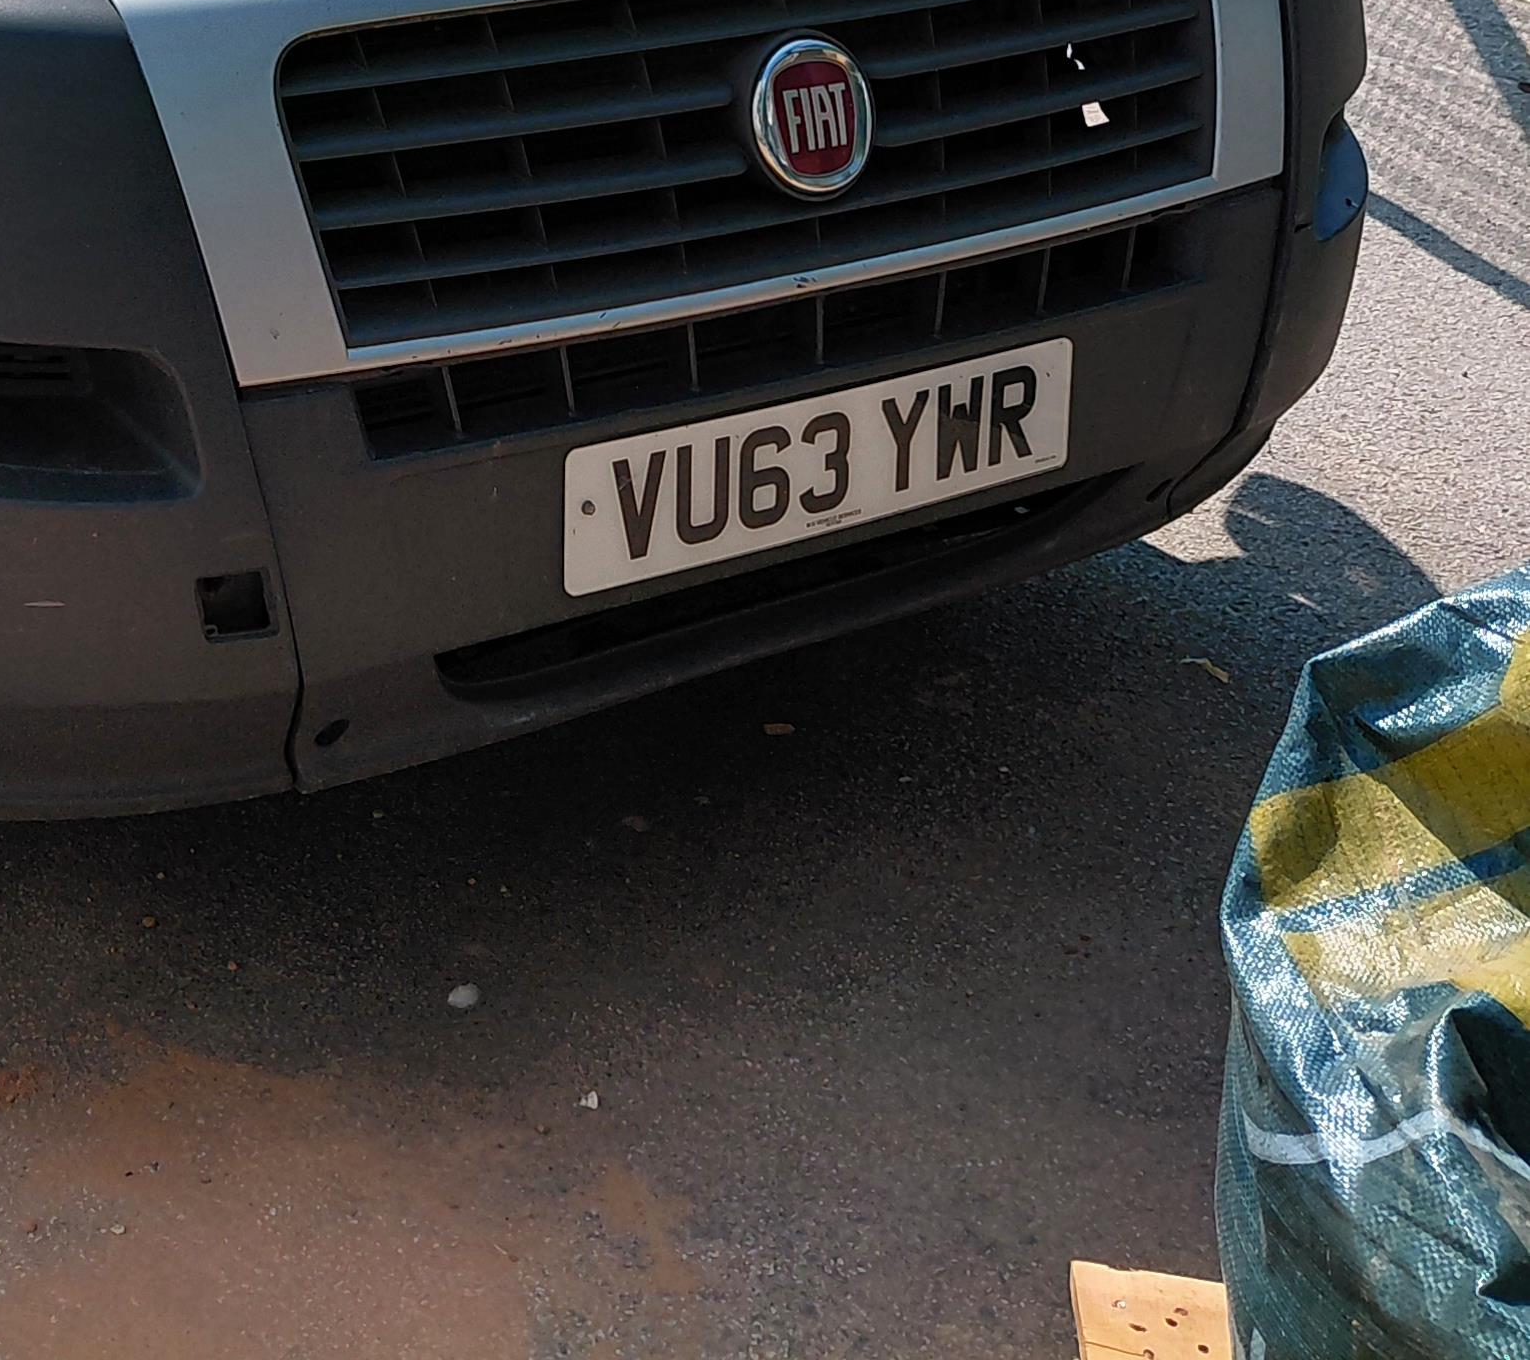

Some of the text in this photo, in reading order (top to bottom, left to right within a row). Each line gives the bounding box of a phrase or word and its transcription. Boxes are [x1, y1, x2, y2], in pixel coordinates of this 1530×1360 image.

[782, 82, 848, 154] FIAT
[611, 364, 1038, 561] VU63 YWR
